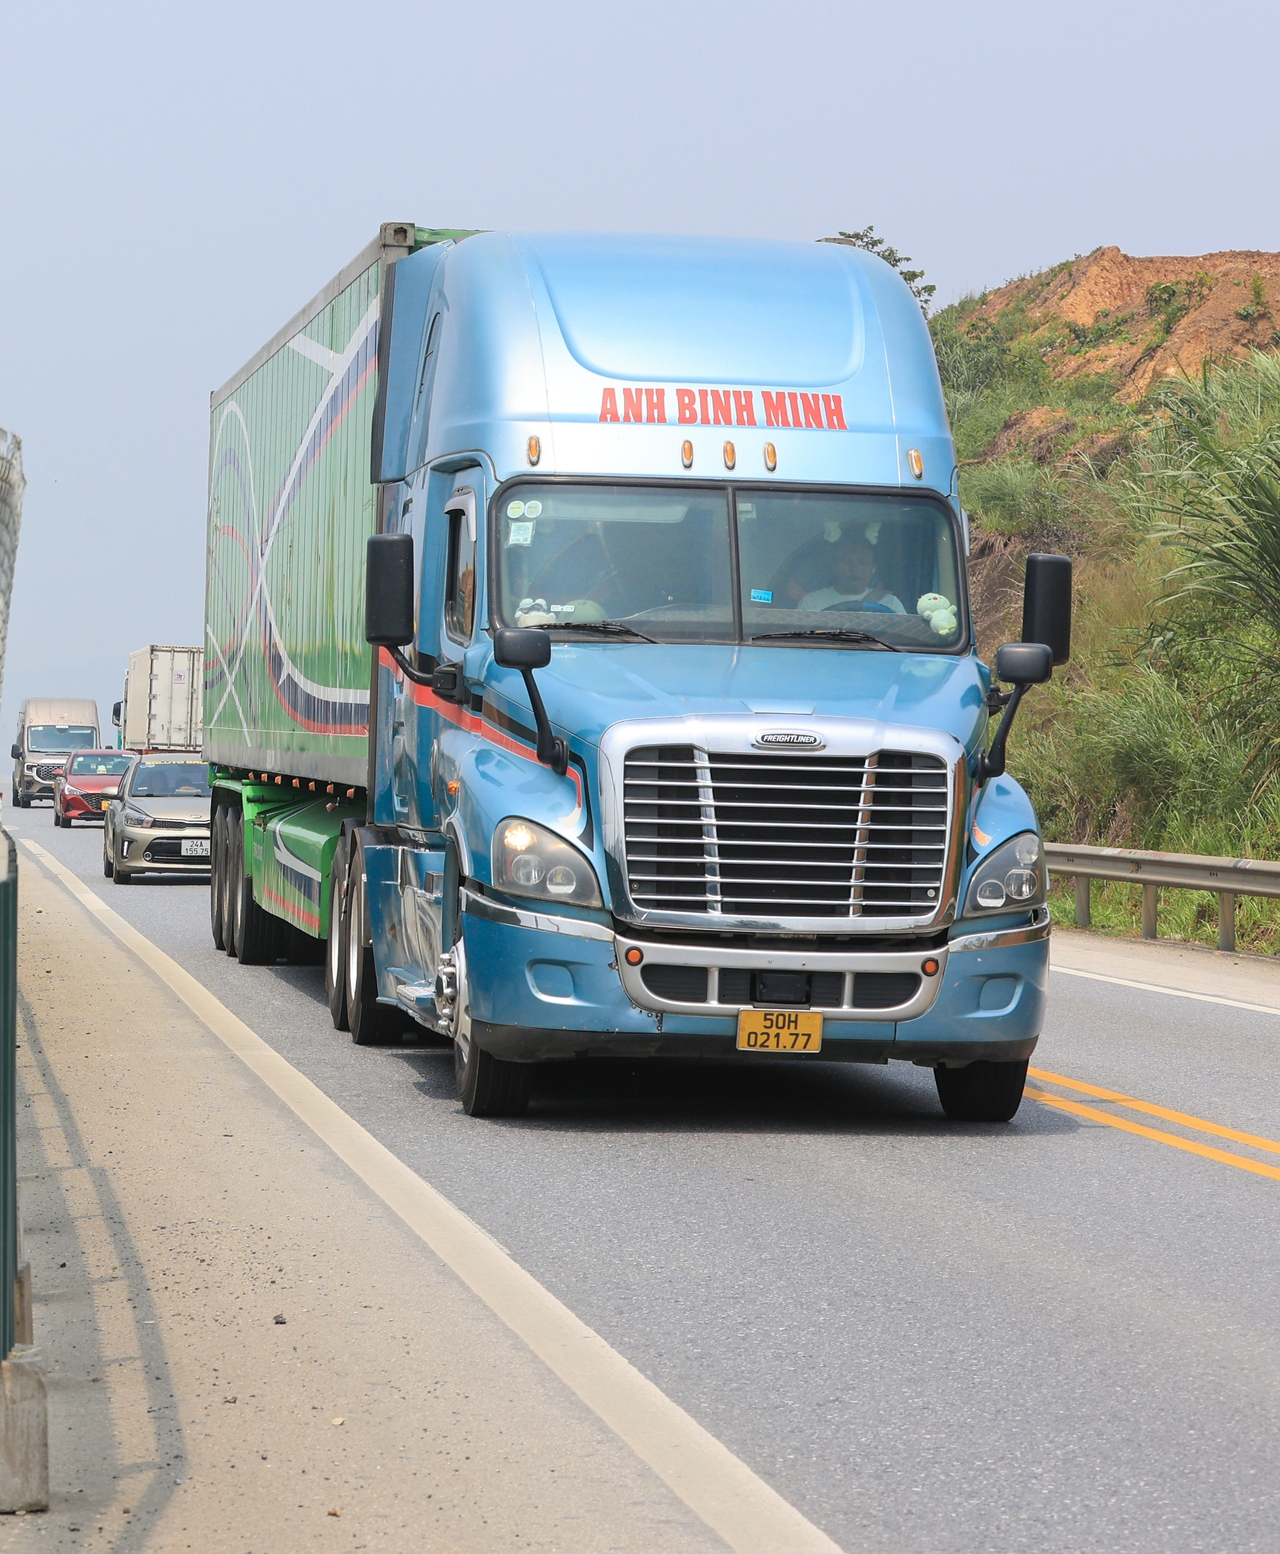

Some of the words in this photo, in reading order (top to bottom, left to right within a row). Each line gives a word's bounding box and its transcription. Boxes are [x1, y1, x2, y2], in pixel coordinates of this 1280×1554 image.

[599, 388, 667, 423] ANH
[676, 388, 758, 426] BINH
[761, 390, 849, 430] MINH
[763, 734, 815, 744] FREIGHTLINER
[763, 1012, 799, 1030] 50H
[747, 1031, 812, 1050] 021.77
